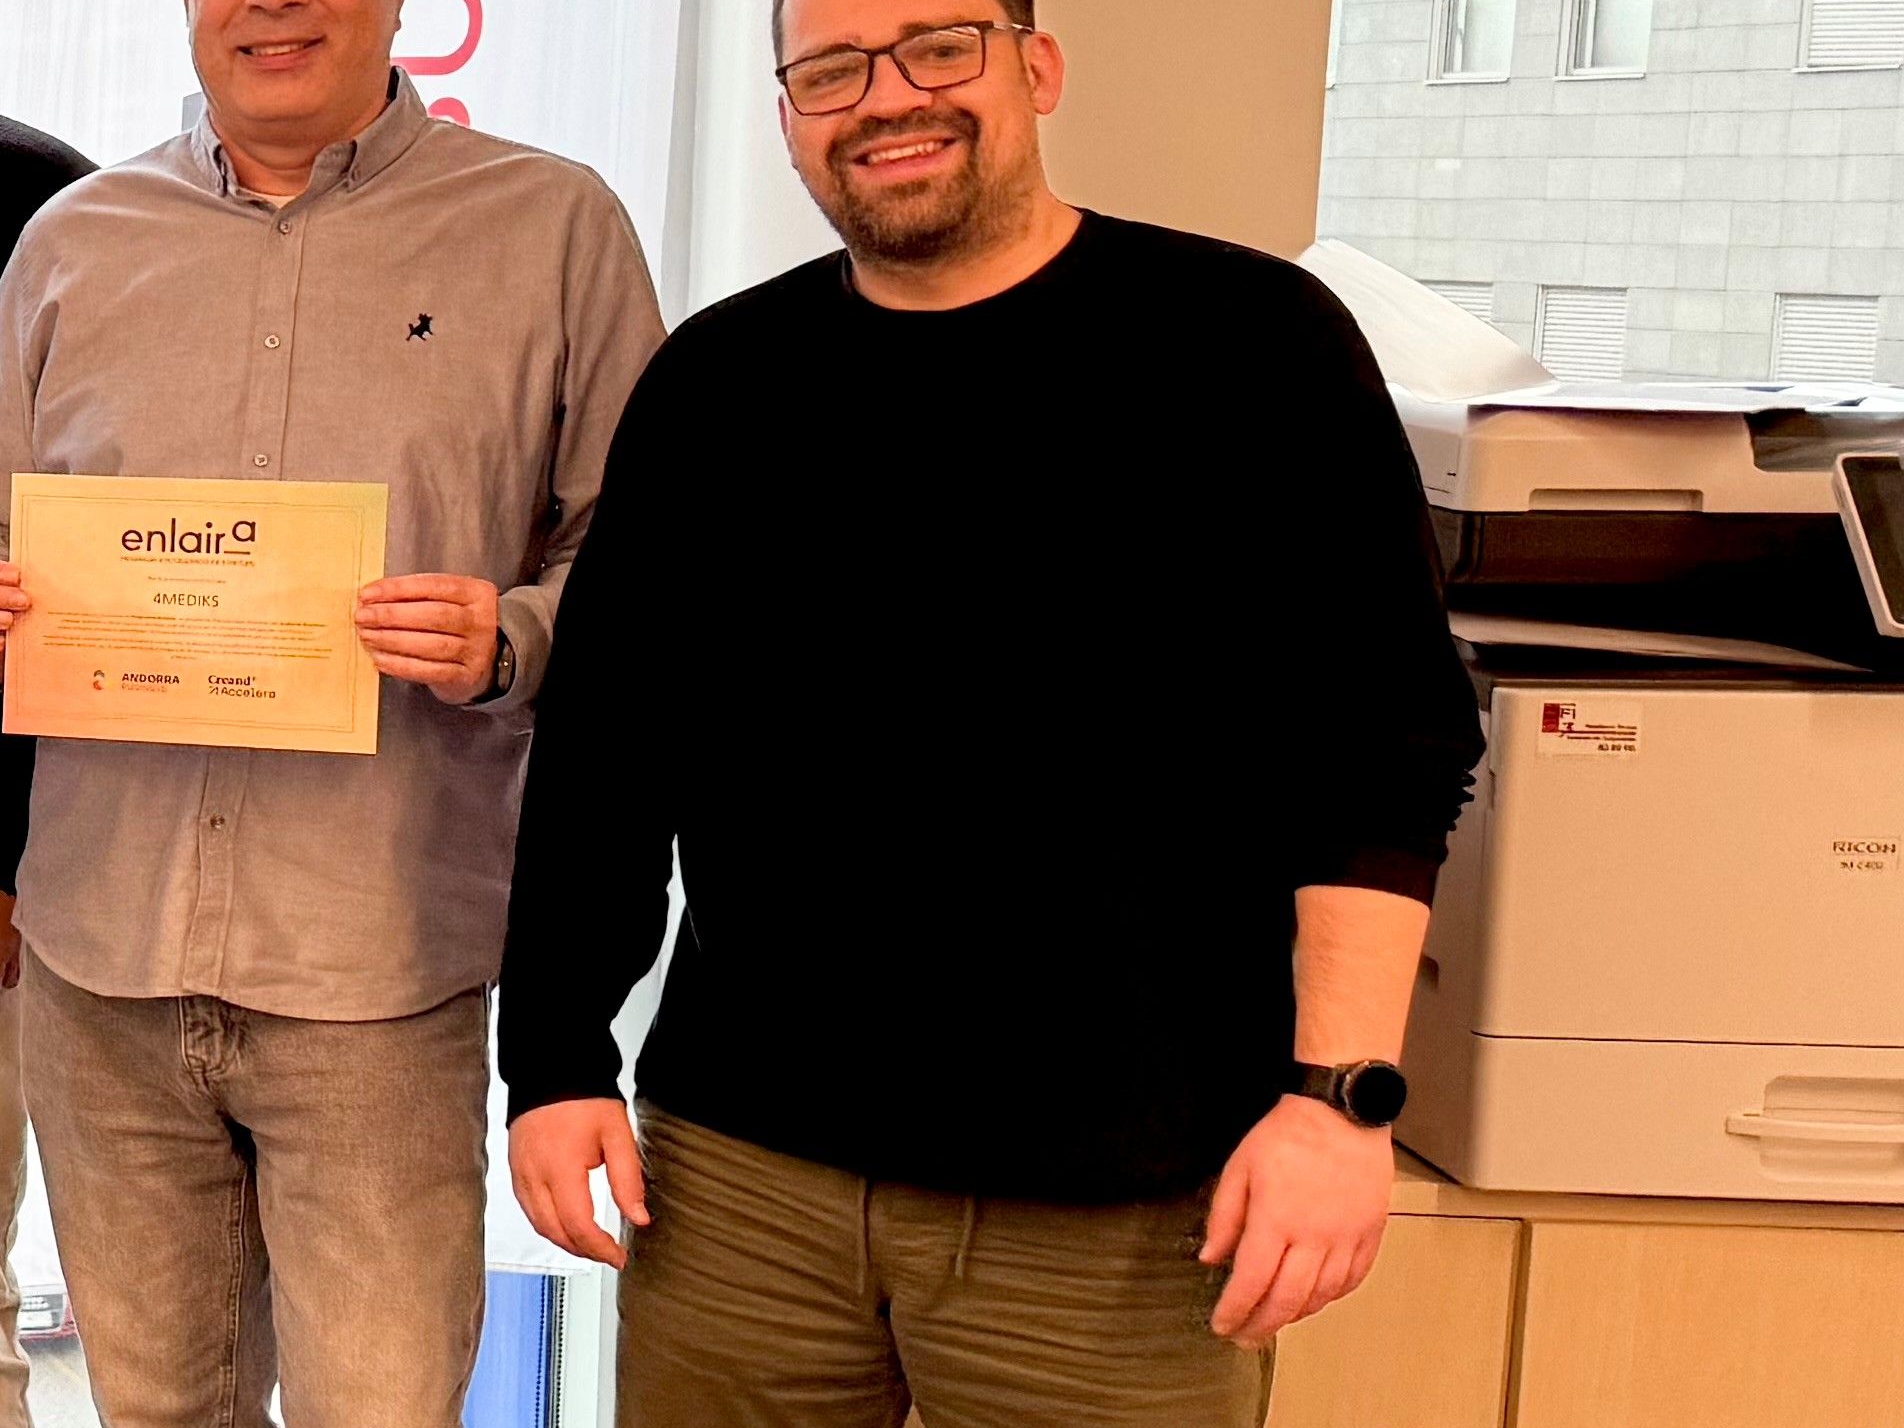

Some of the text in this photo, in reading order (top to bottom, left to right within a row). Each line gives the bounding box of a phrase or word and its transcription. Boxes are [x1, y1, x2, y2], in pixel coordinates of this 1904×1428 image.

[153, 592, 219, 608] 4MEDIKS
[121, 673, 180, 685] ANDORRA
[1832, 841, 1897, 854] RICOH
